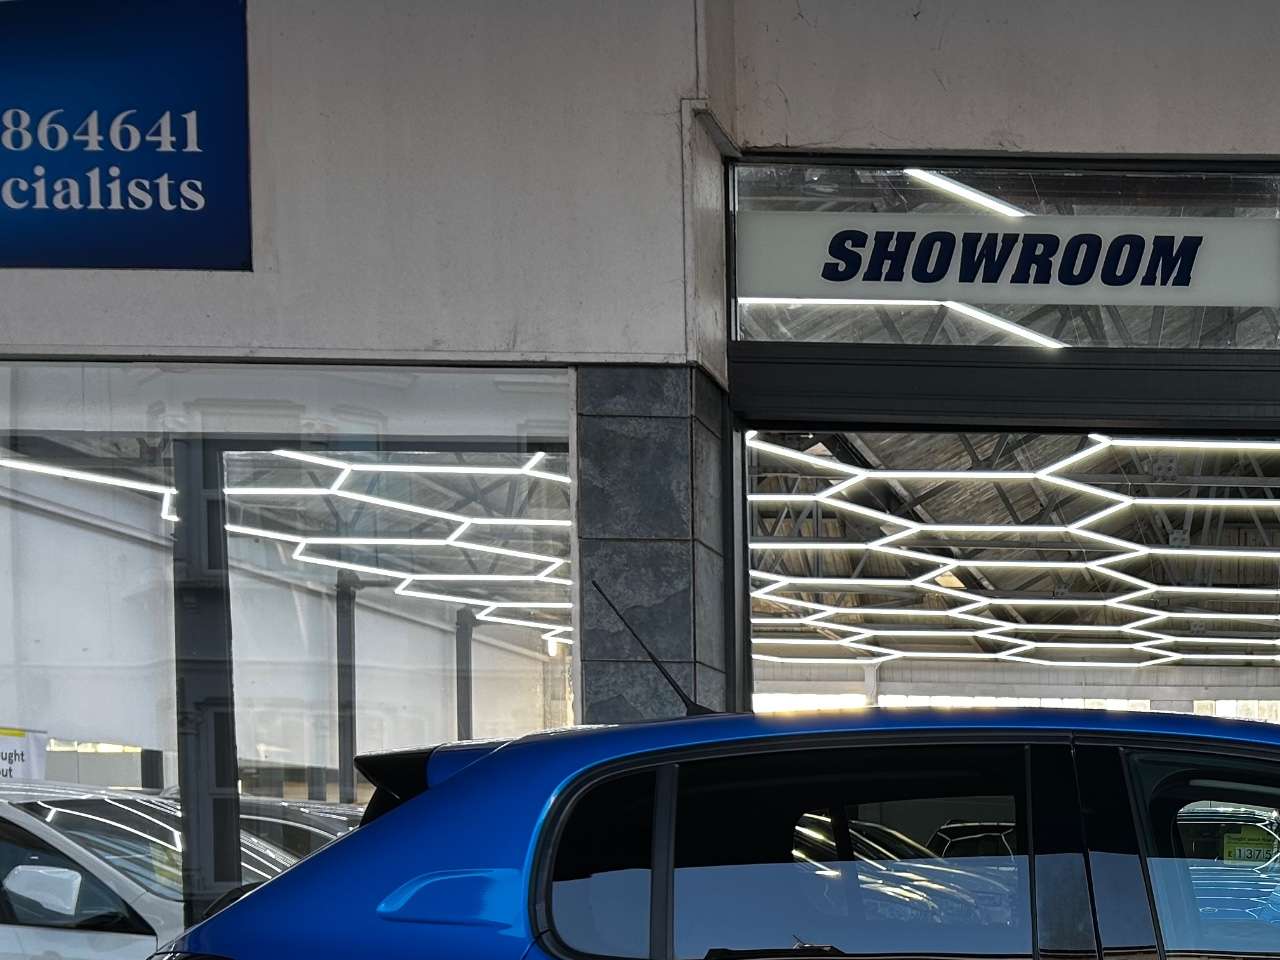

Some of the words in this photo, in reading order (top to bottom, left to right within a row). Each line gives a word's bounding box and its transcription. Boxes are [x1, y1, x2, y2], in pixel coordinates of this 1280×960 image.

[1, 108, 203, 152] 864641
[1, 165, 206, 211] cialists
[821, 230, 1203, 287] SHOWROOM
[0, 767, 12, 778] ut
